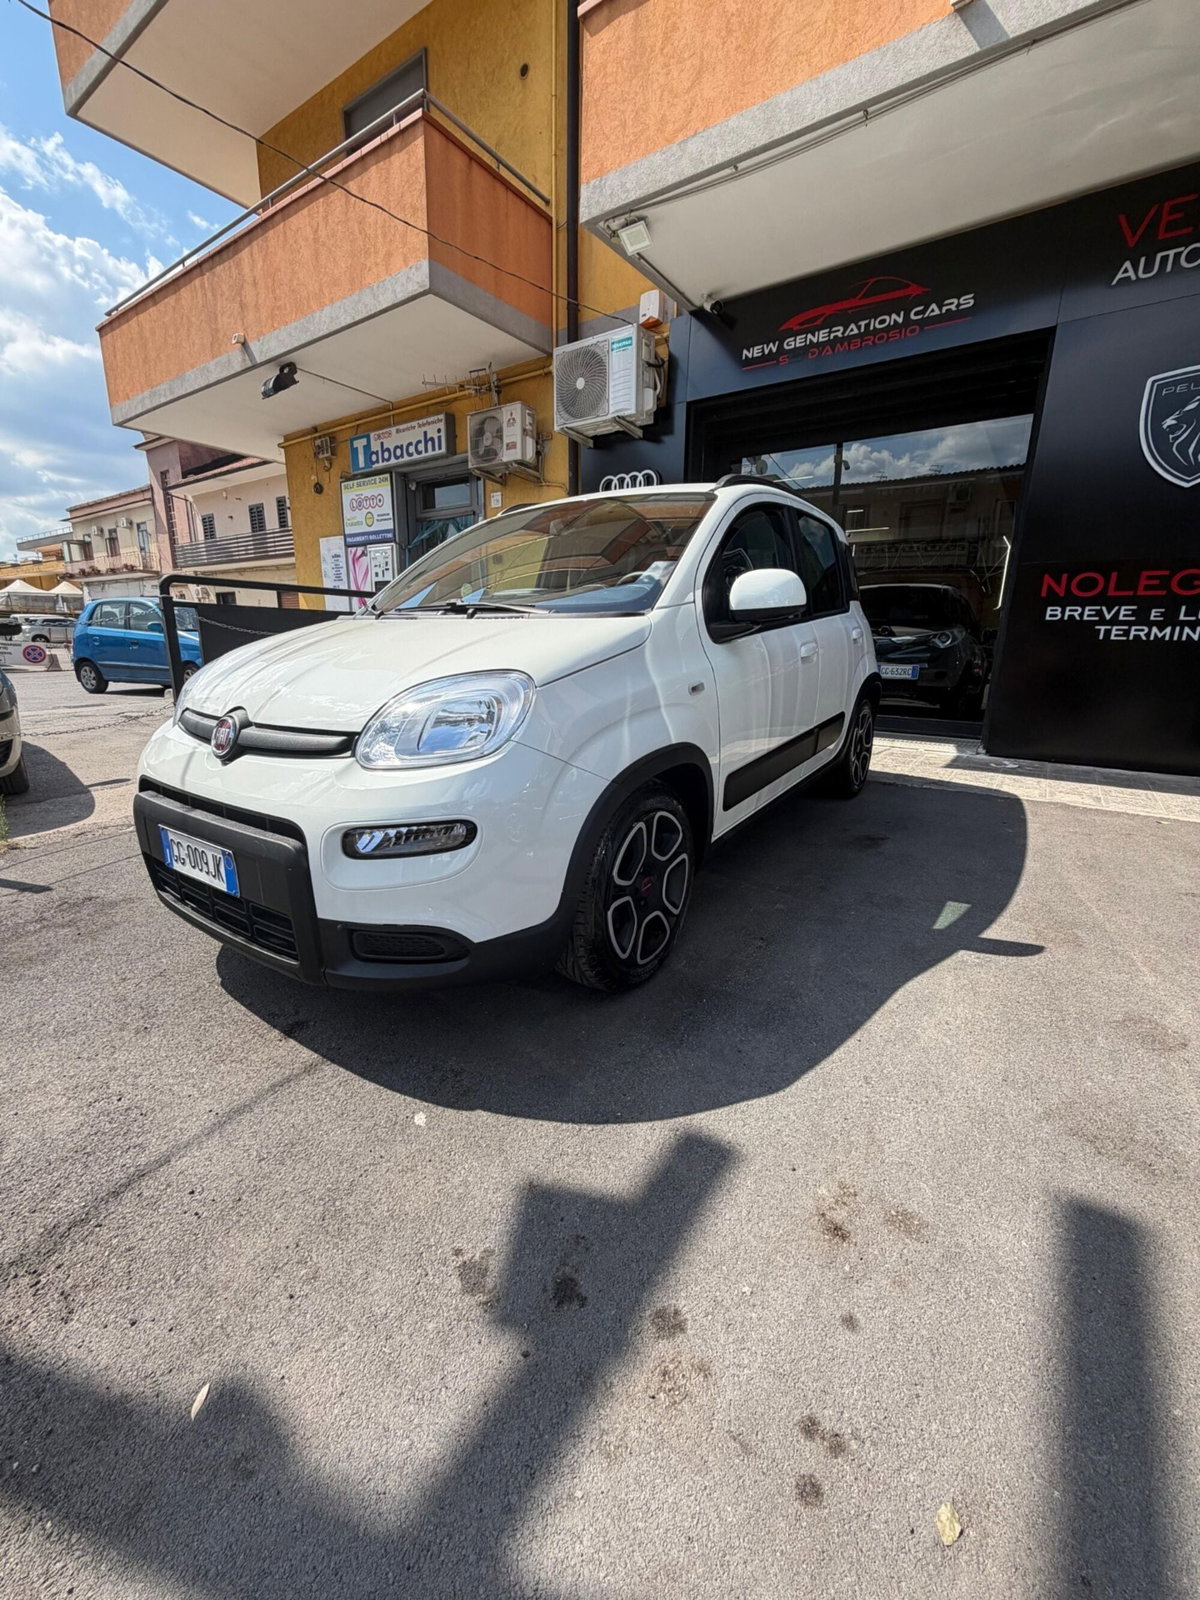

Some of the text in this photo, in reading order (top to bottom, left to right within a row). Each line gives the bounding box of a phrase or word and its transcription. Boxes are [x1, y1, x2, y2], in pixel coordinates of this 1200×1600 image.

[1117, 193, 1200, 248] VE
[742, 293, 975, 360] NEW GENERATION CARS
[808, 325, 920, 359] D'AMBROSIO
[353, 428, 442, 468] Tabacchi
[356, 479, 378, 488] SERVICE
[350, 493, 384, 511] LOTTO
[1045, 605, 1138, 621] BREVE
